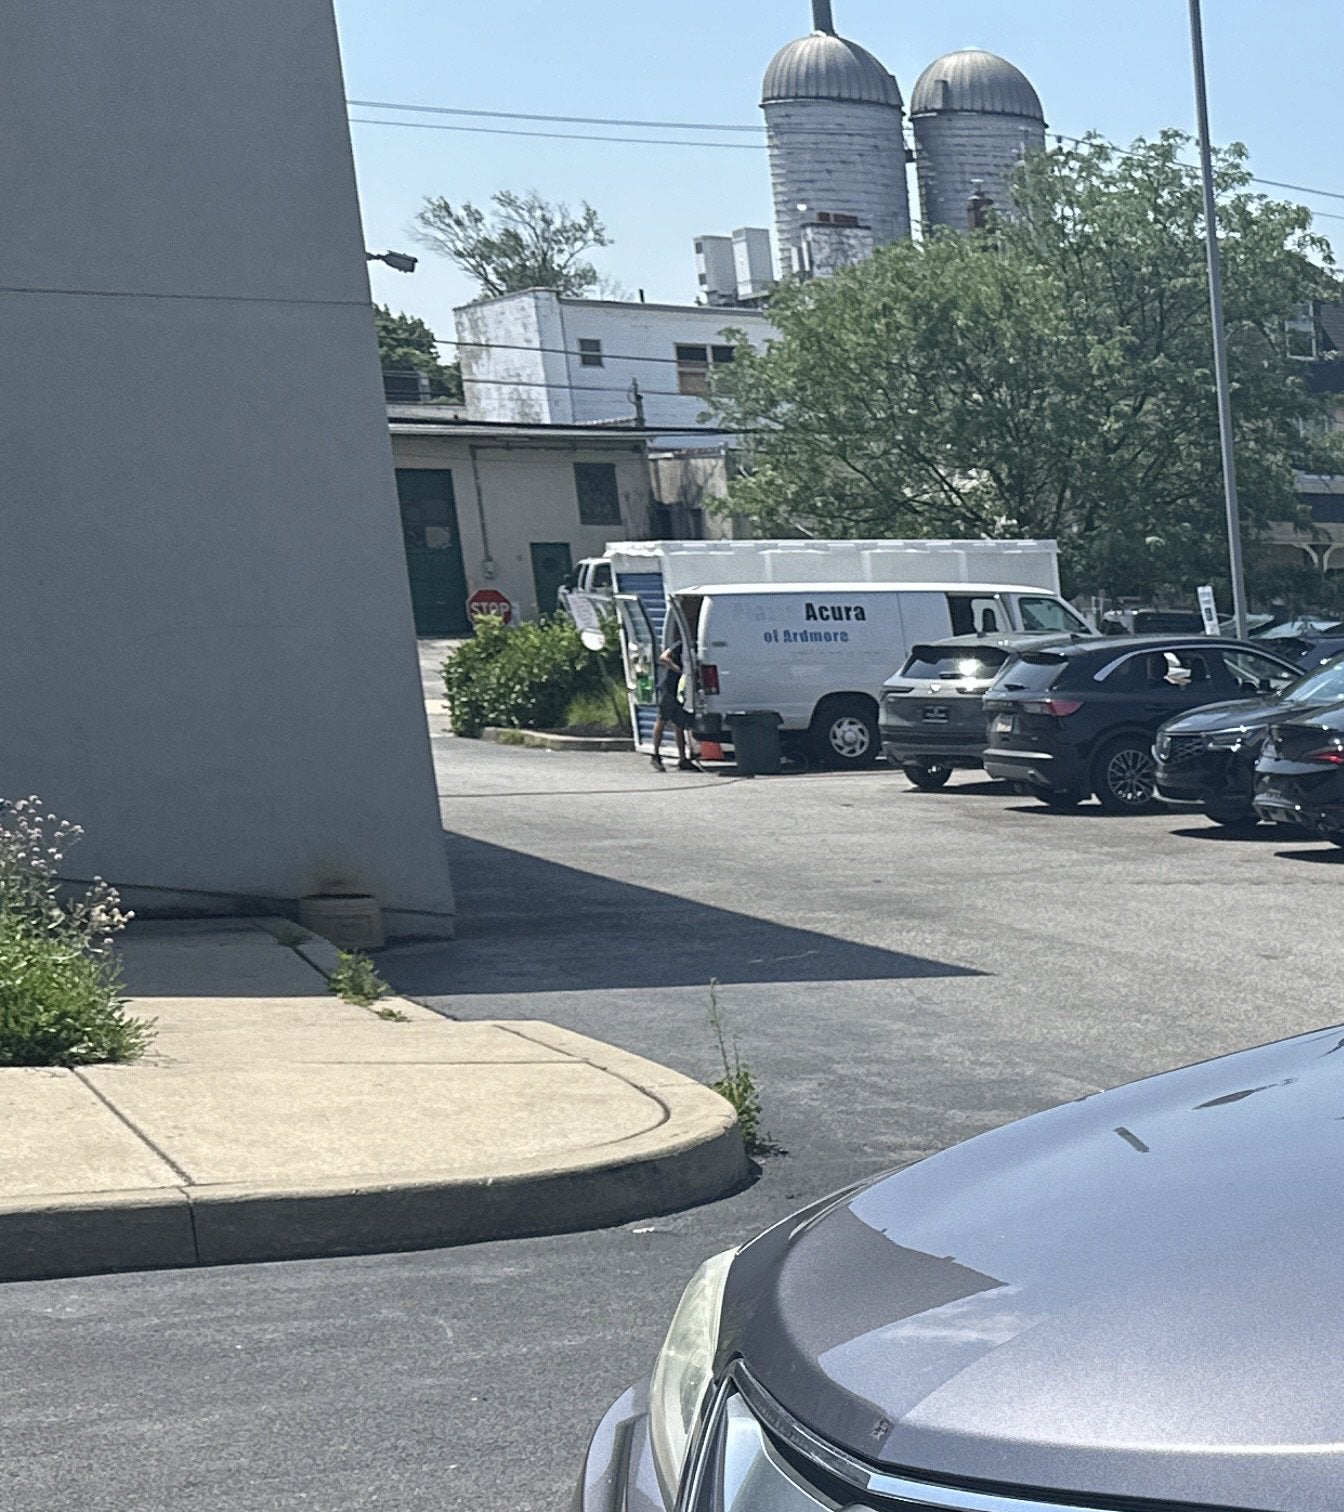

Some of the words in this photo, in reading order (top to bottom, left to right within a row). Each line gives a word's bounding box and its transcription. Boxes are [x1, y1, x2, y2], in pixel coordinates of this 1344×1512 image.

[804, 602, 866, 621] Acura
[763, 629, 779, 643] of
[783, 629, 849, 643] Ardmore
